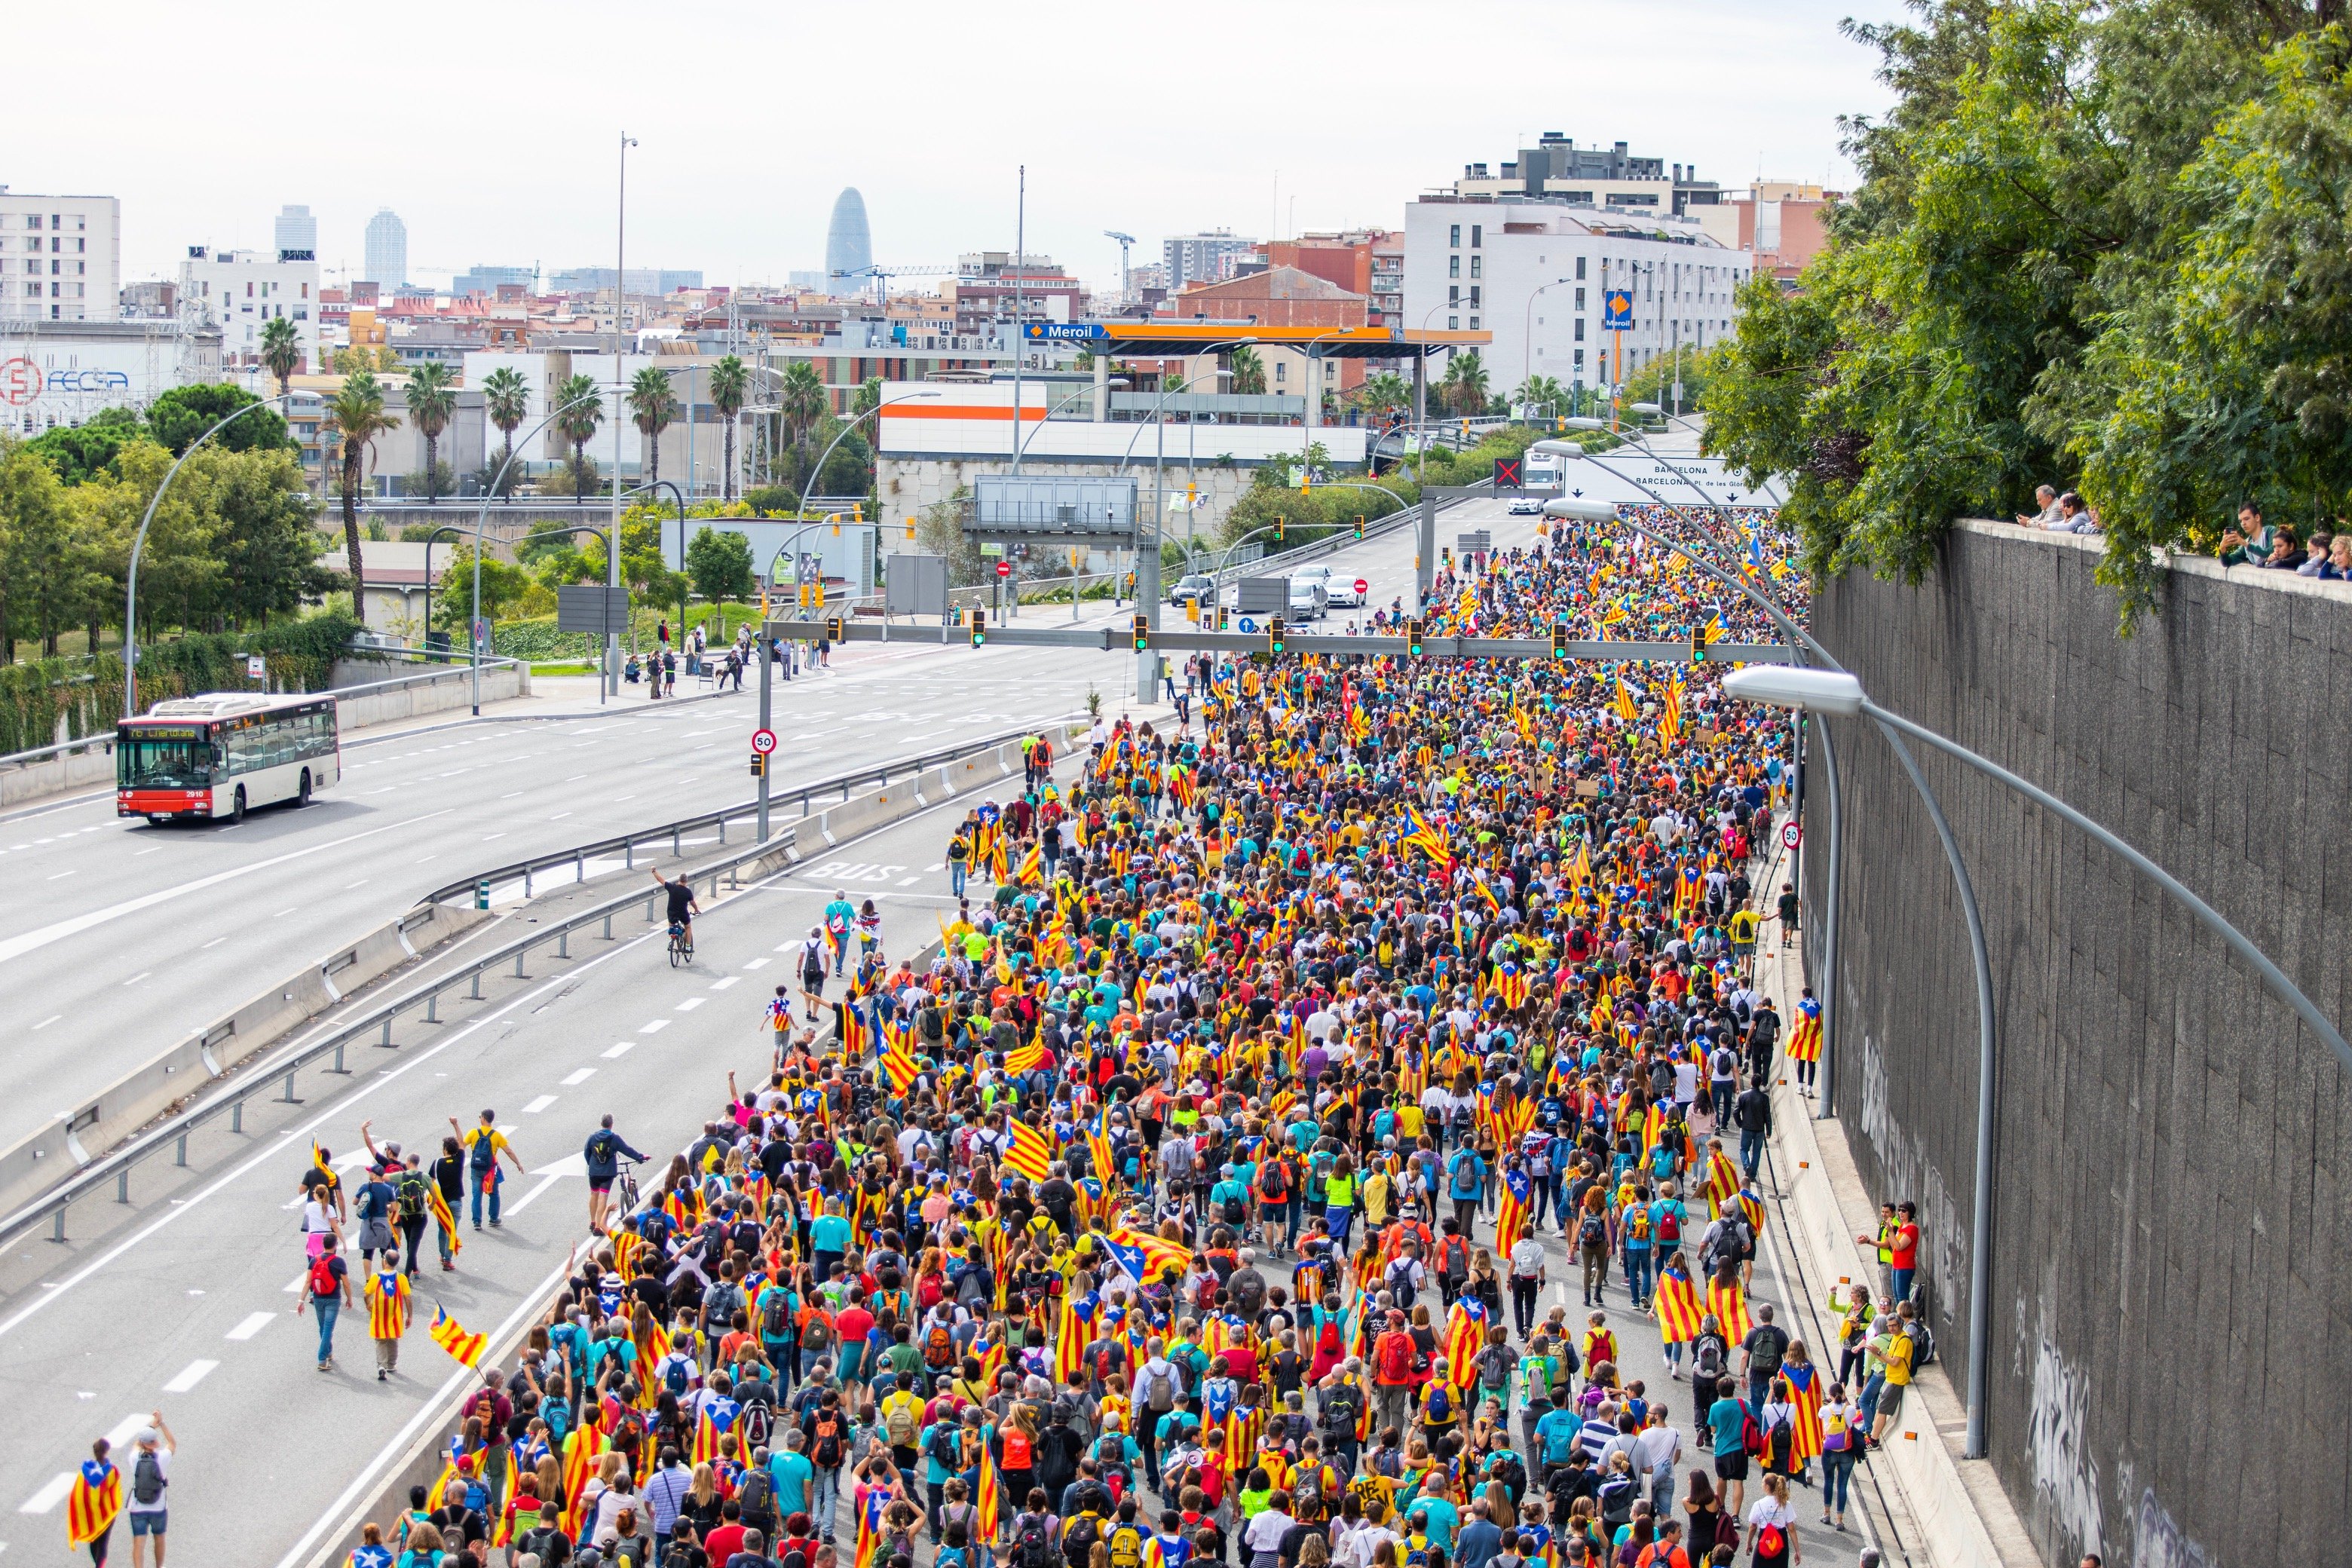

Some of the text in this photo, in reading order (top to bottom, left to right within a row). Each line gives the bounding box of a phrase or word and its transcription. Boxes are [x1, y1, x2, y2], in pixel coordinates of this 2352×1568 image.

[1049, 326, 1092, 337] Meroil
[757, 737, 771, 746] 50
[1786, 830, 1796, 841] 50
[803, 862, 908, 881] BUS
